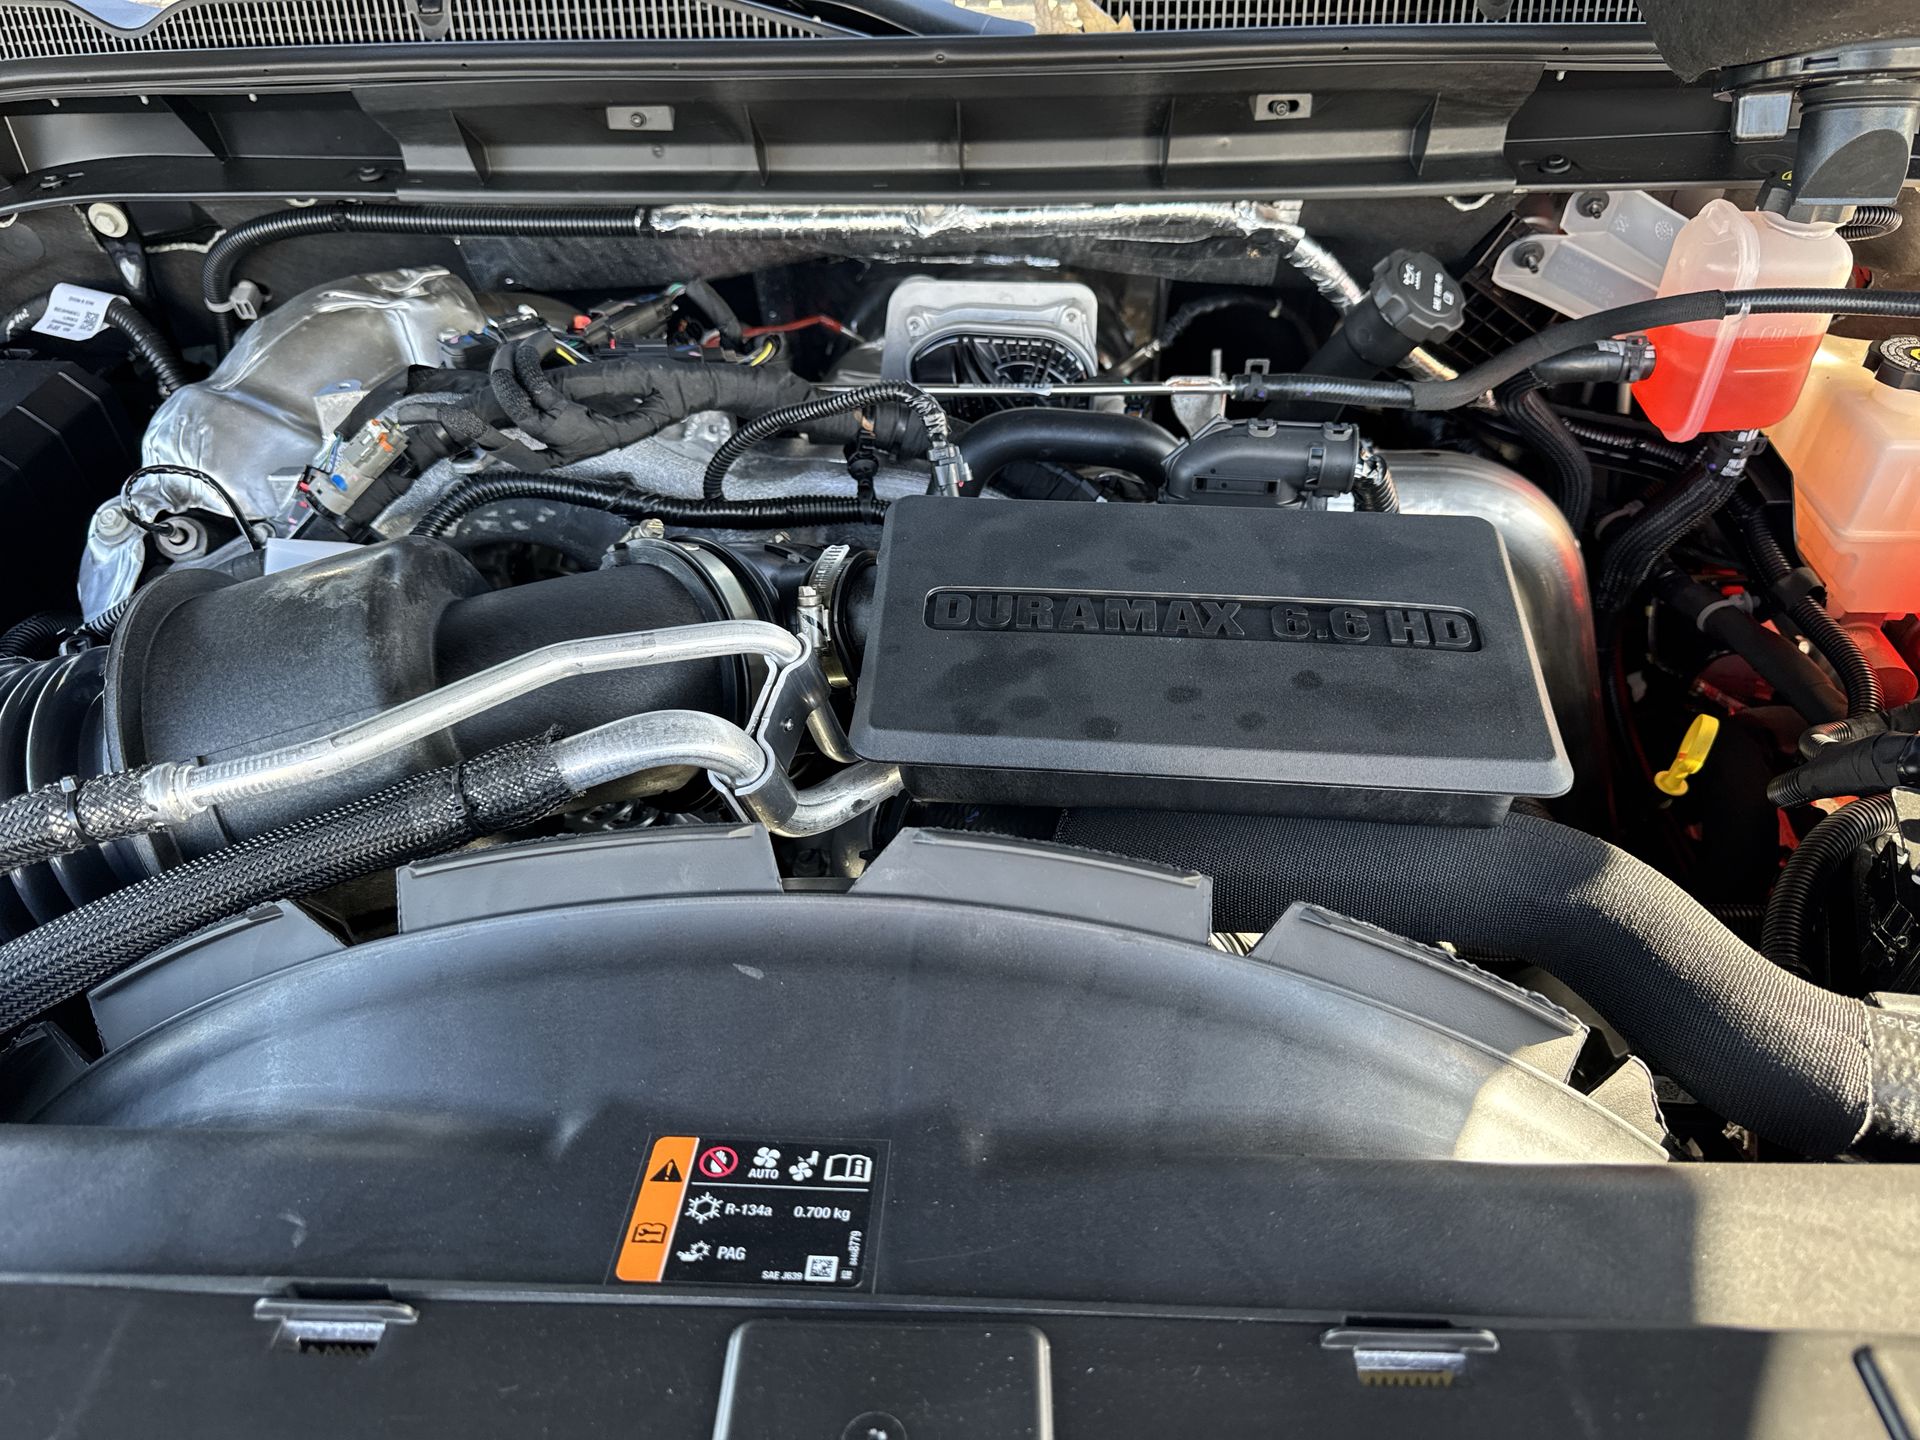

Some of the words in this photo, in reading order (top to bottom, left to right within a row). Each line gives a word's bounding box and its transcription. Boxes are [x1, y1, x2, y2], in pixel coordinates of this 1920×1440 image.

[933, 593, 1245, 636] DURAMAX
[1271, 604, 1370, 642] 6.6
[1386, 609, 1472, 647] HD
[748, 1169, 779, 1180] AUTO
[724, 1203, 773, 1217] R-134a
[793, 1206, 832, 1219] 0.700
[833, 1208, 850, 1221] kg
[716, 1246, 747, 1261] PAG
[761, 1270, 780, 1280] SAE
[781, 1272, 803, 1280] J639
